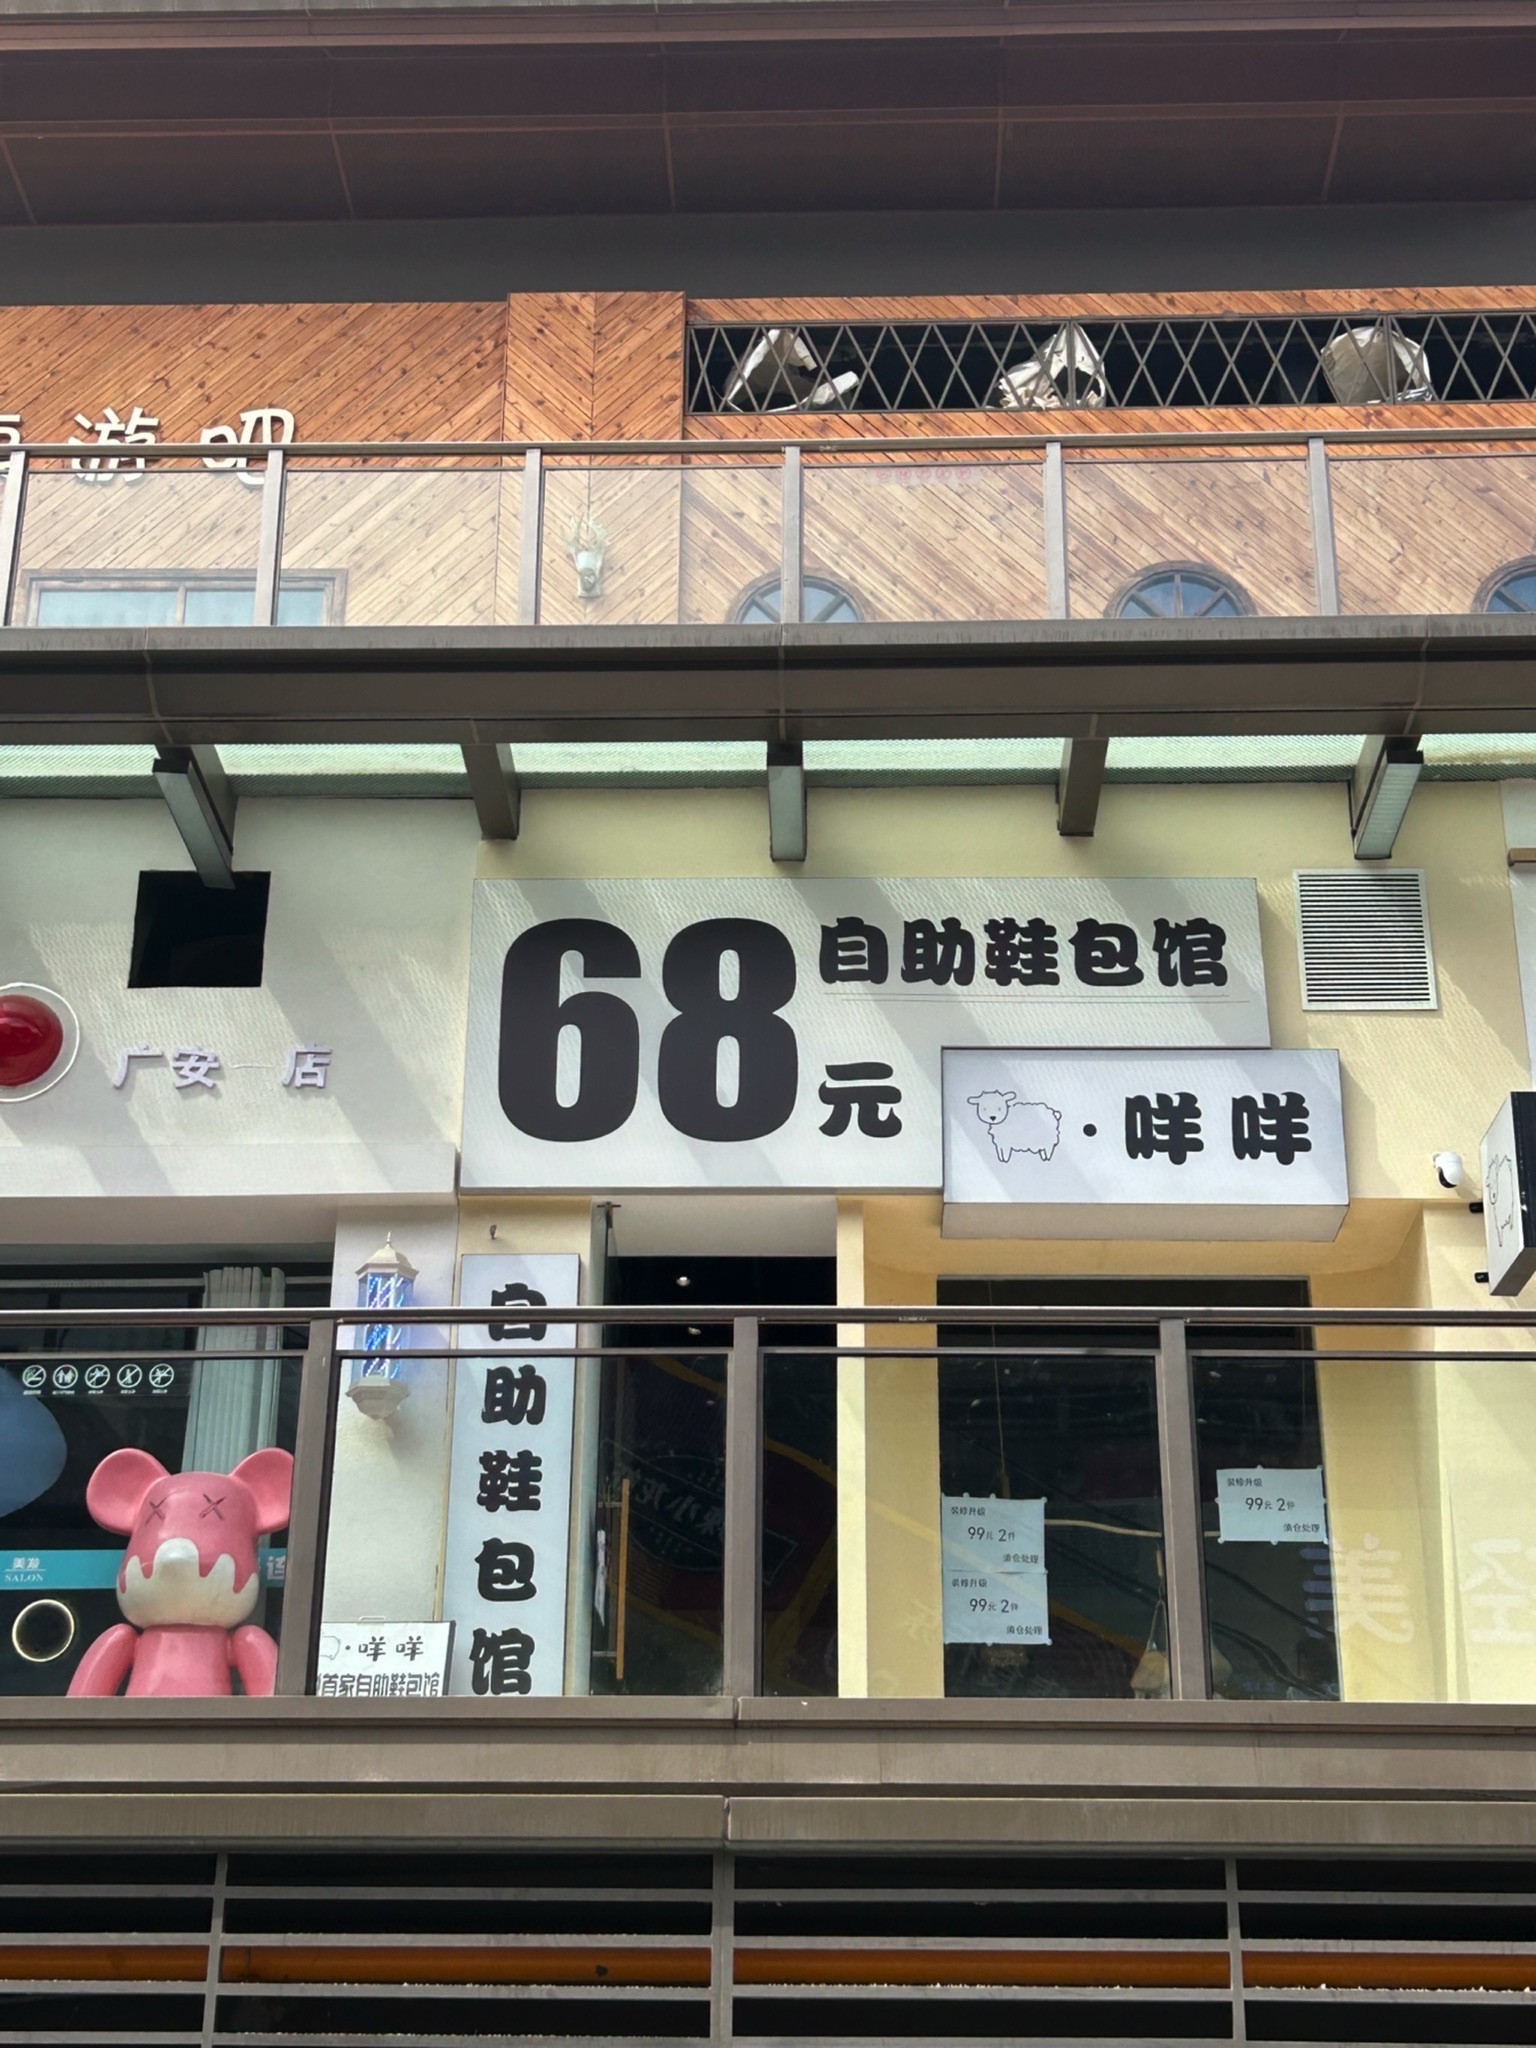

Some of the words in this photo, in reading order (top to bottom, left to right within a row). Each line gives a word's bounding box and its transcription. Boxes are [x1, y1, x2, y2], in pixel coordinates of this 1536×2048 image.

[818, 916, 1228, 987] 自助鞋包馆
[469, 1282, 548, 1696] 自助鞋包馆
